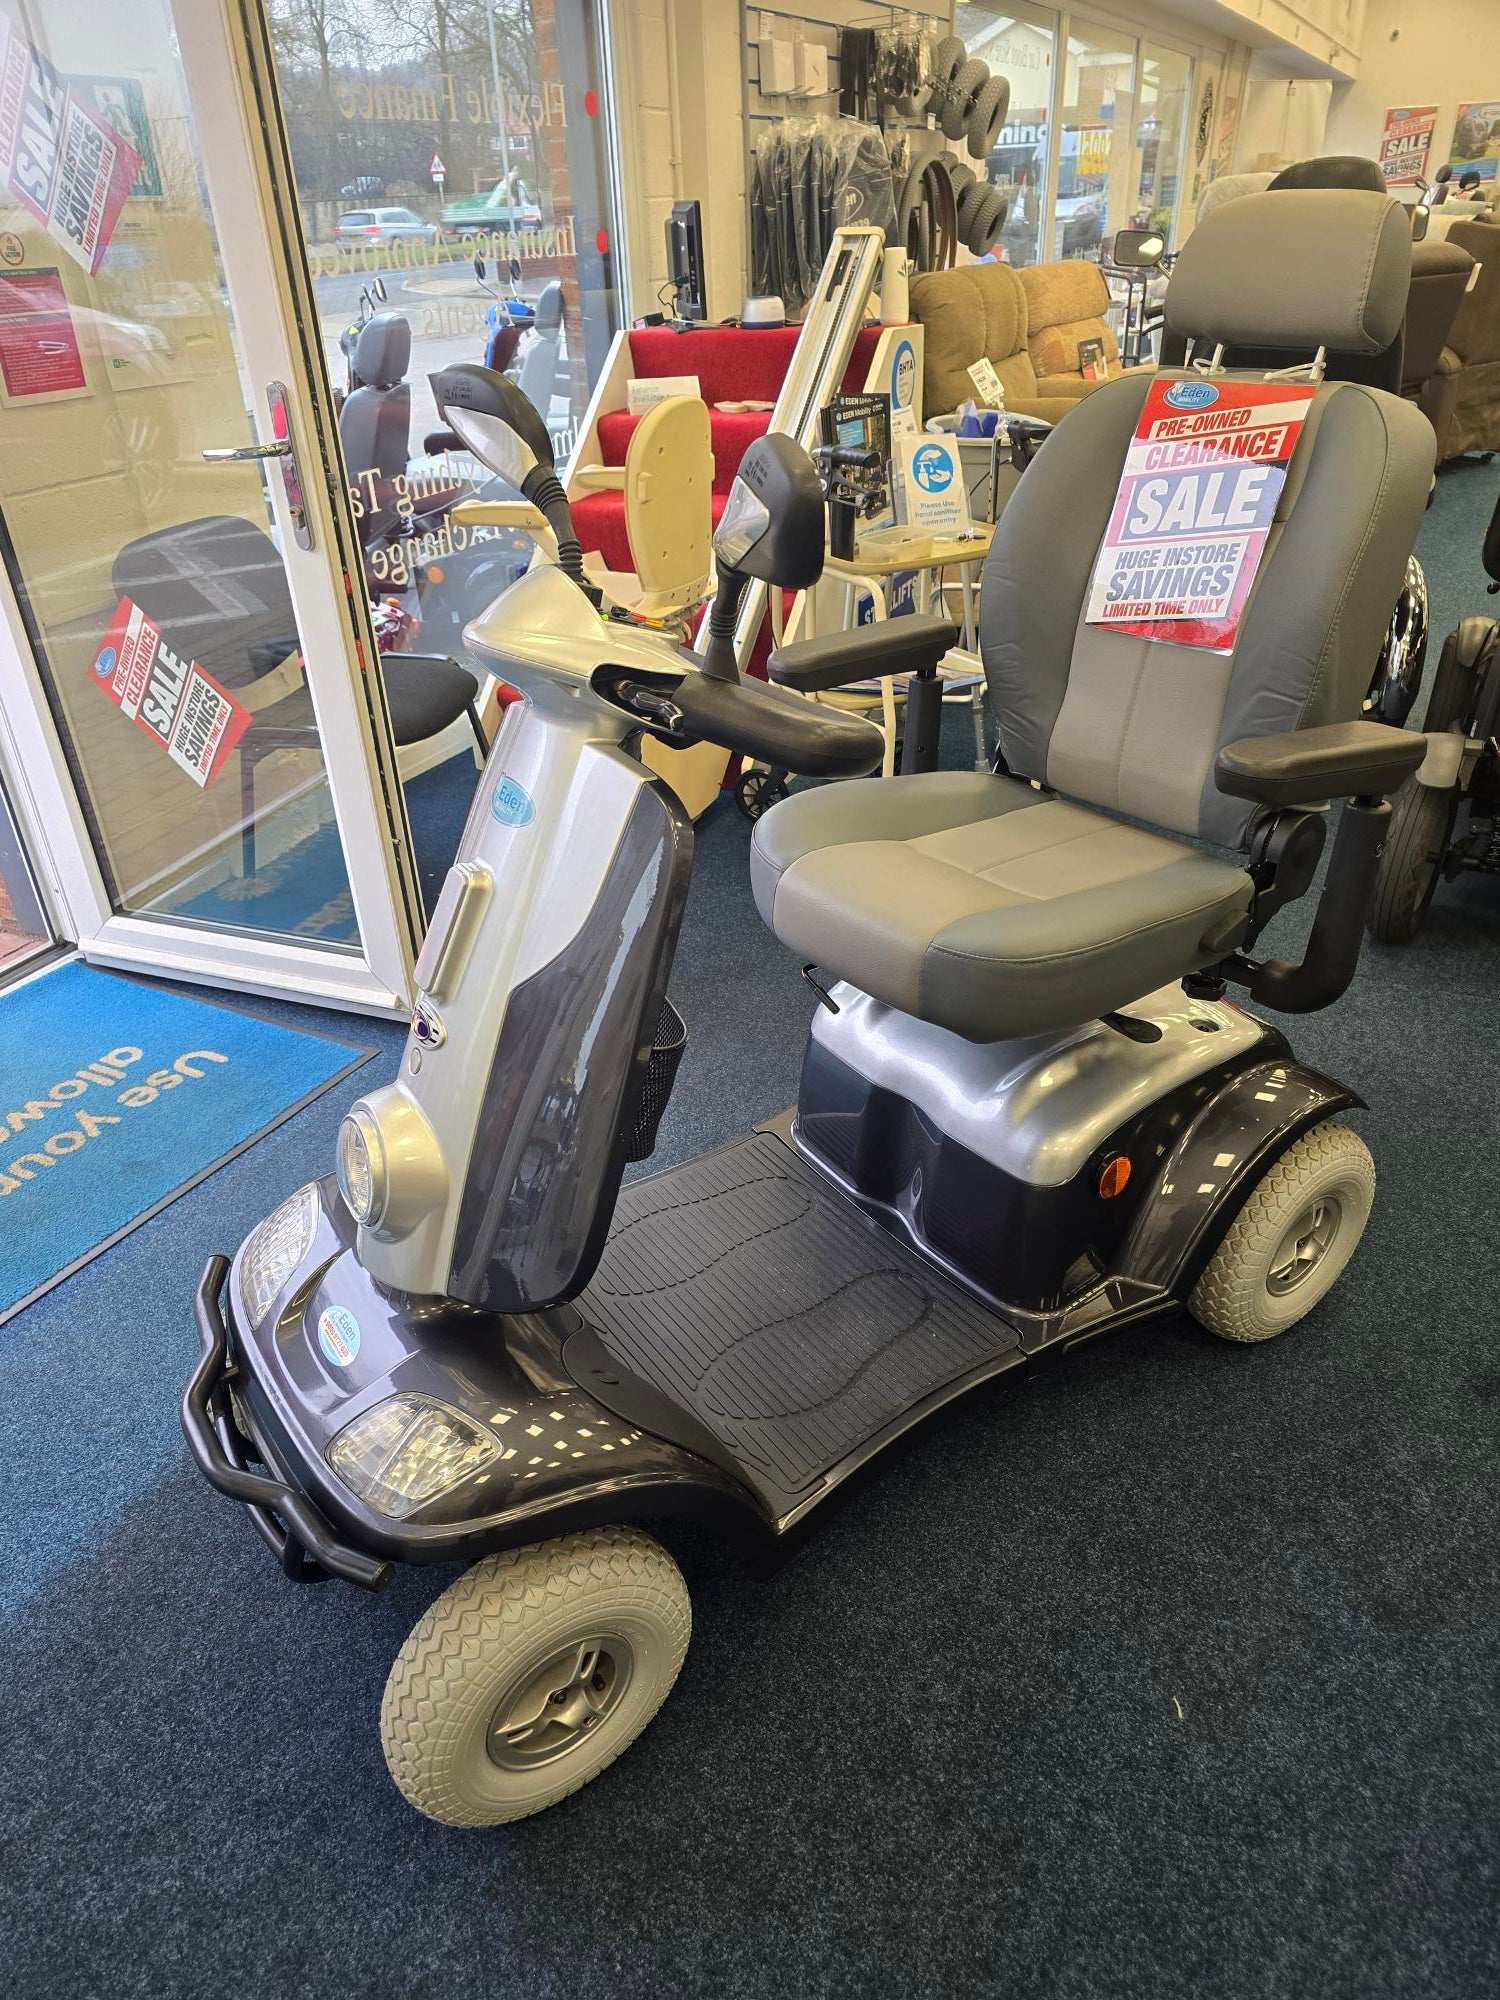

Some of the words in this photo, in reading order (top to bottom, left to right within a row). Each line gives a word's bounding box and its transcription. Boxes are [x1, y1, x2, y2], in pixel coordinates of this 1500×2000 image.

[1387, 133, 1429, 156] SALE
[65, 124, 103, 246] SAVINGS
[899, 359, 913, 375] BHTA
[1181, 386, 1210, 398] Eden
[1156, 409, 1252, 438] PRE-OWNED
[1145, 430, 1283, 471] CLEARANCE
[1129, 467, 1270, 535] SALE
[1115, 549, 1160, 570] HUGE
[1163, 542, 1241, 566] INSTORE
[1106, 564, 1234, 601] SAVINGS
[1103, 602, 1151, 618] LIMITED
[1154, 600, 1184, 615] TIME
[1187, 598, 1224, 613] ONLY
[114, 636, 135, 692] PRE-OWNED
[126, 626, 157, 707] CLEARANCE
[143, 641, 189, 734] SALE
[175, 723, 191, 753] HUGE
[183, 678, 206, 726] INSTORE
[183, 688, 220, 768] SAVINGS
[198, 745, 213, 776] LIMITED
[211, 725, 222, 747] TIME
[217, 703, 230, 727] ONLY
[117, 1049, 230, 1108] Use
[339, 1313, 356, 1340] Eden
